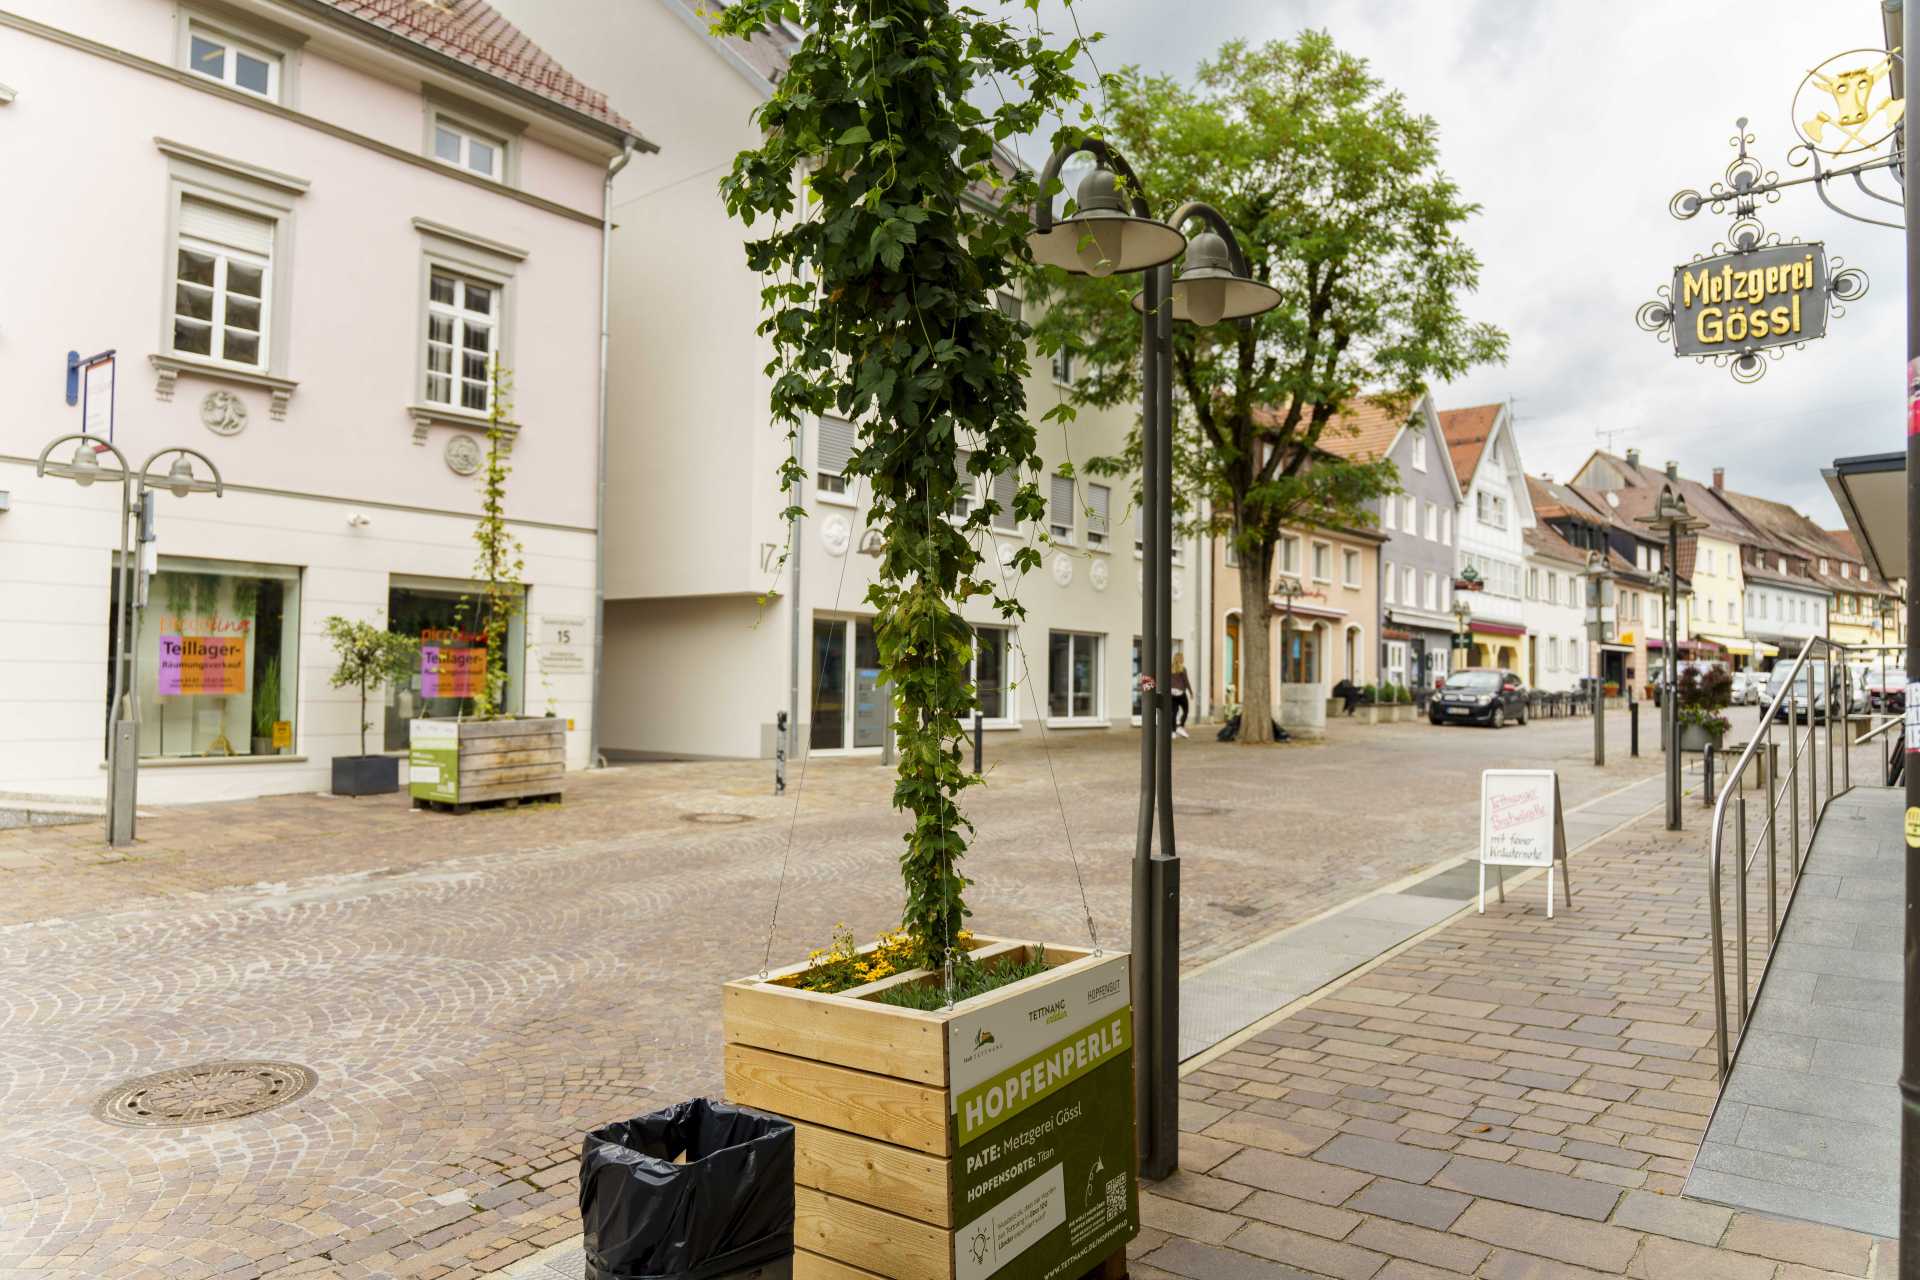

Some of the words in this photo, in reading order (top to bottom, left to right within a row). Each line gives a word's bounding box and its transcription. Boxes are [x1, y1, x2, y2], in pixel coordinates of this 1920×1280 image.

[1683, 253, 1814, 308] Metzgerei
[1696, 294, 1801, 344] Gössl
[164, 641, 240, 659] Teillager-
[557, 630, 571, 644] 15
[1028, 999, 1066, 1022] TETTNANG
[1087, 979, 1121, 1000] HOPFENGUT
[965, 1019, 1123, 1132] HOPFENPERLE
[966, 1144, 1001, 1174] PATE:
[1003, 1116, 1054, 1154] Metzgerei
[1056, 1101, 1082, 1127] Gössl
[967, 1157, 1036, 1203] HOPFENSORTE:
[1037, 1148, 1055, 1164] Titan
